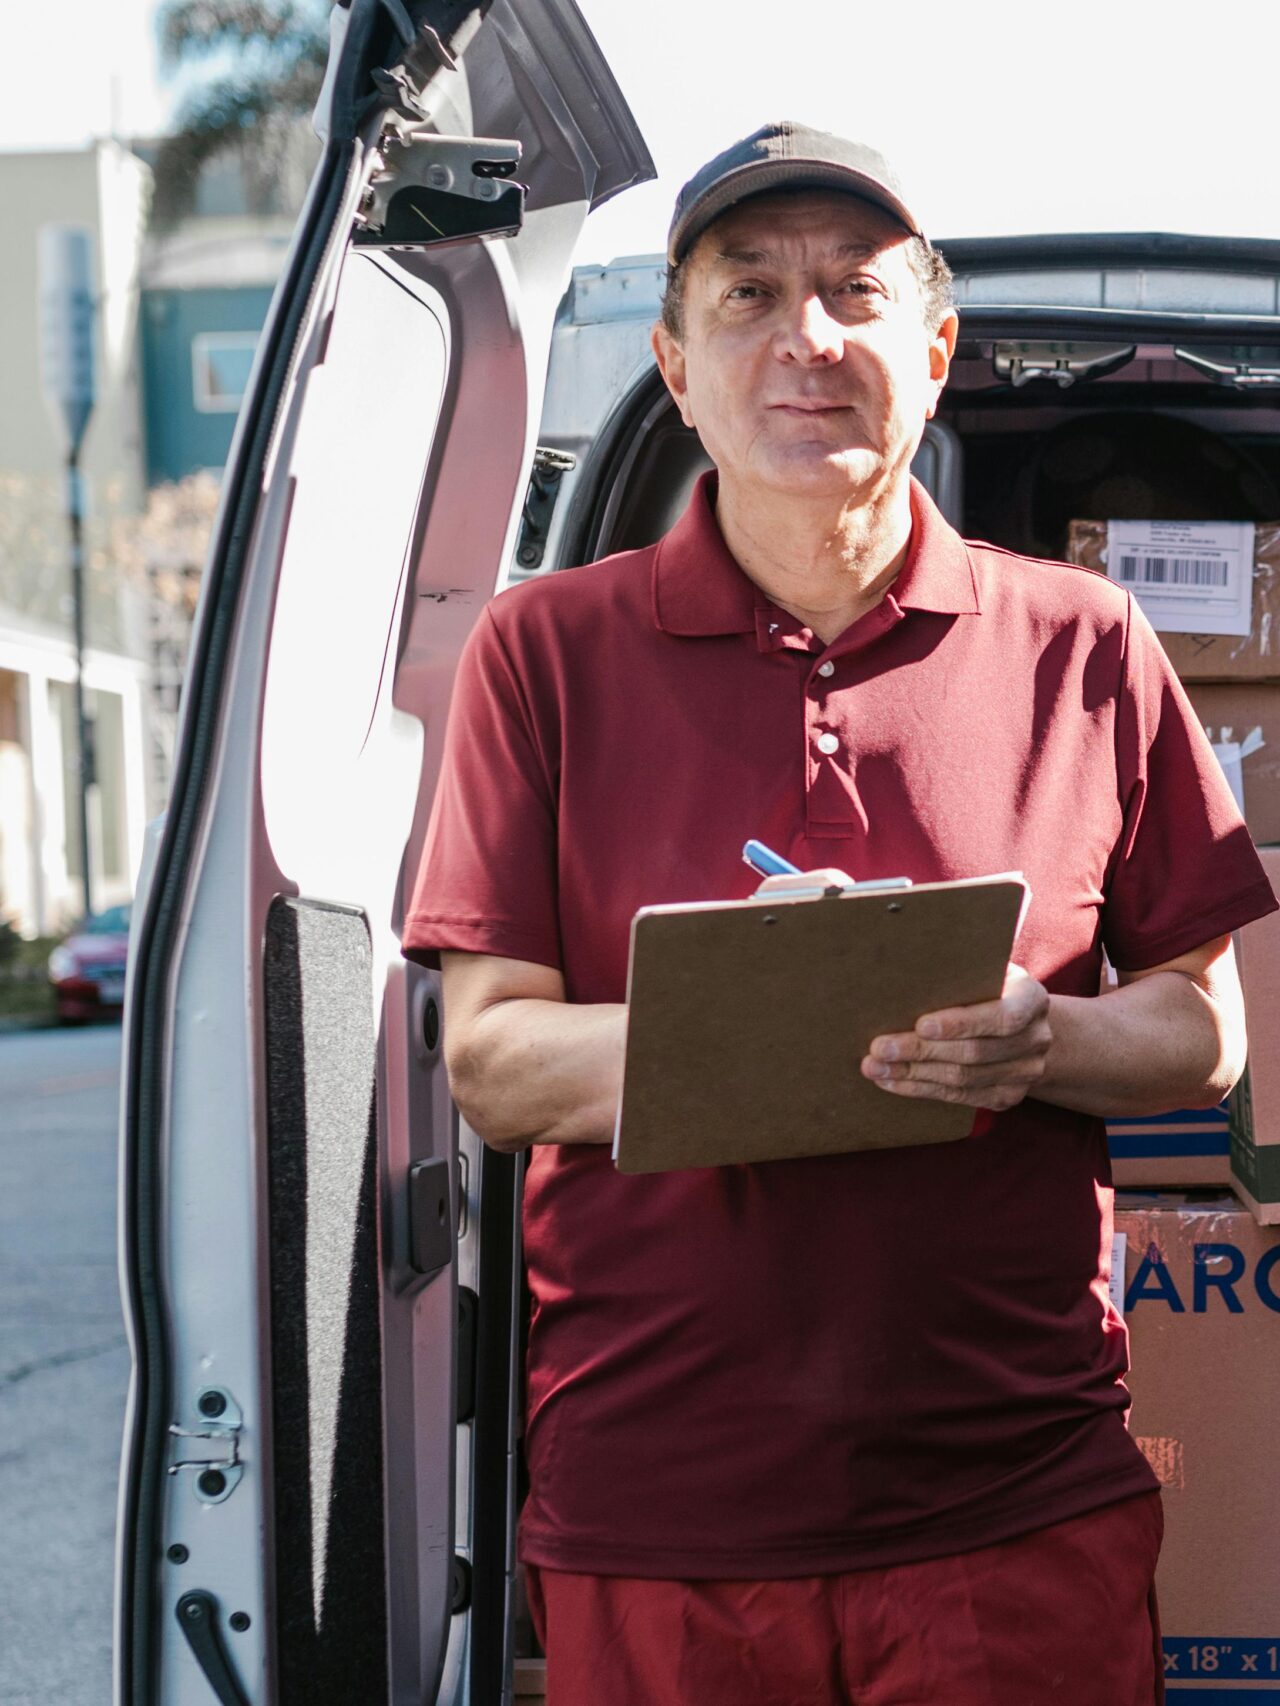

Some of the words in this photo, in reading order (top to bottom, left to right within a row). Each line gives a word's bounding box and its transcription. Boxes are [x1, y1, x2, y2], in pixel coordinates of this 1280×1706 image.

[1163, 1653, 1180, 1671] x
[1188, 1645, 1233, 1672] 18"
[1240, 1654, 1259, 1672] x
